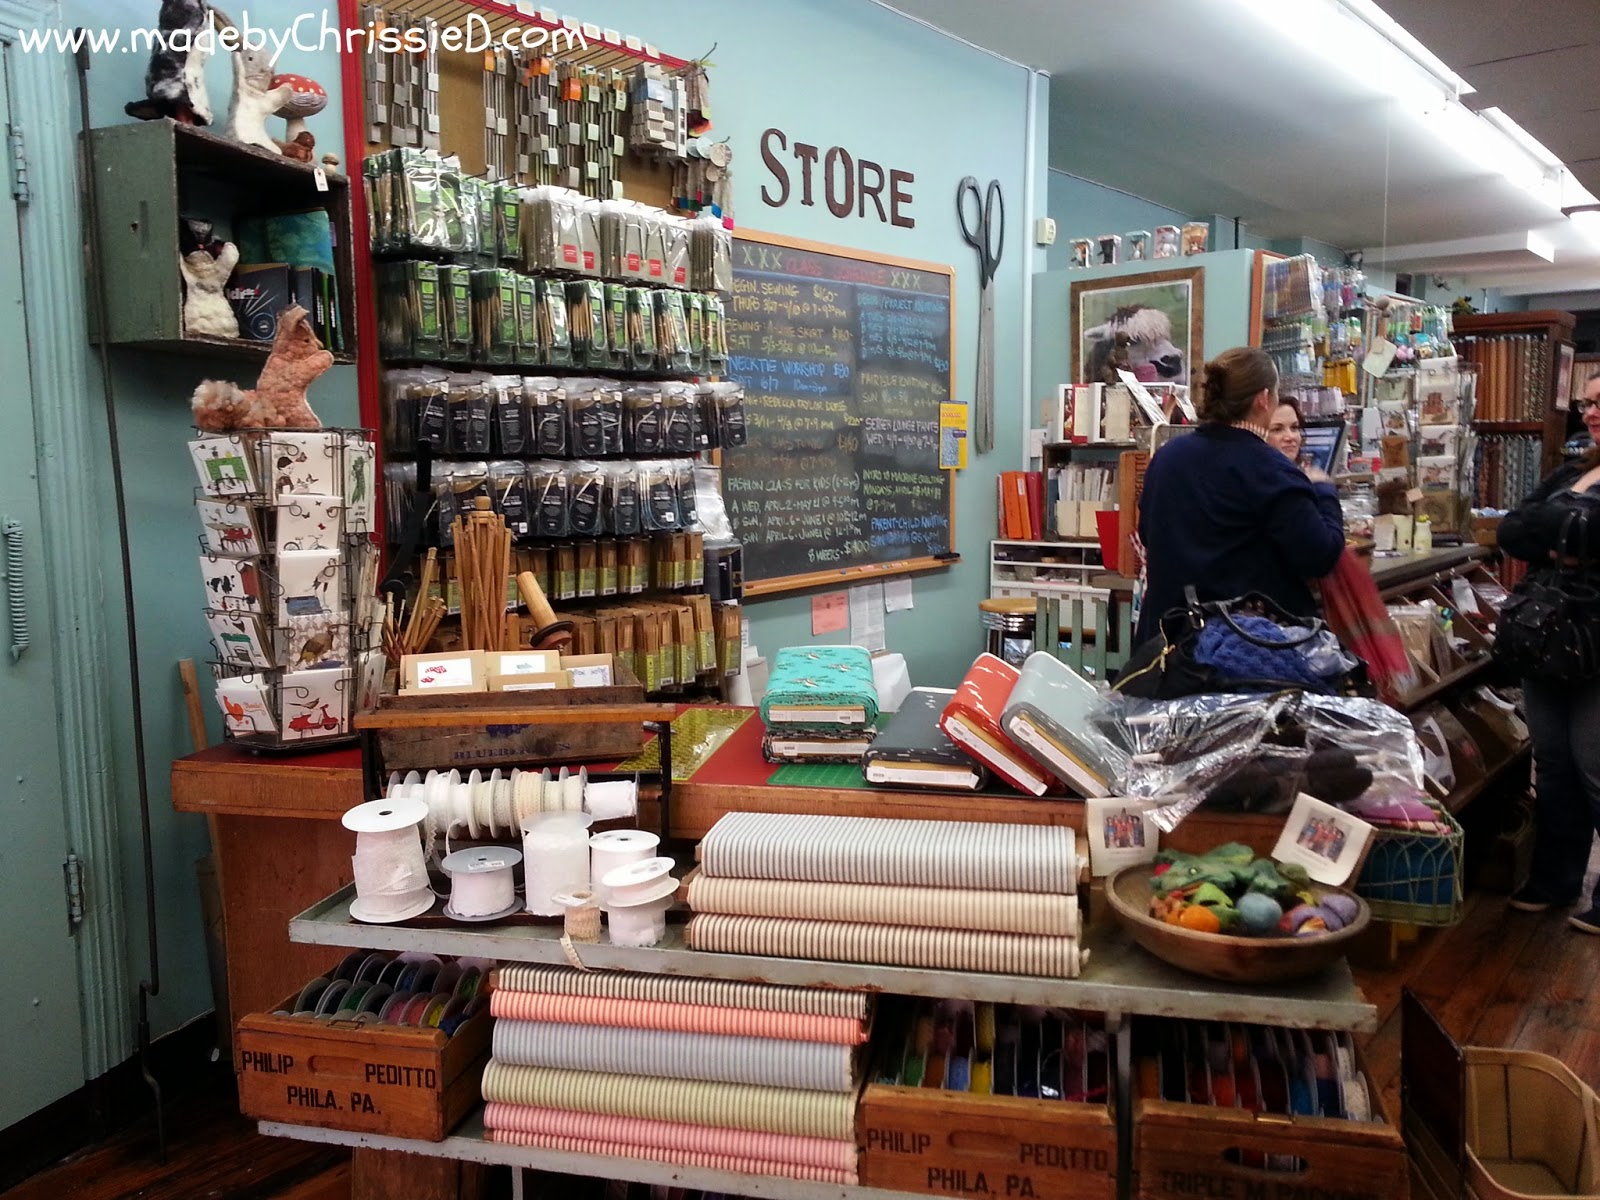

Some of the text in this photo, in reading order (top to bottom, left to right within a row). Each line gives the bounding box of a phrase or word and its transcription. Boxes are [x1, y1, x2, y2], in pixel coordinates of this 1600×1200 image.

[760, 128, 915, 229] STORE
[761, 282, 799, 297] SEWING
[728, 356, 777, 374] NECKTIE
[782, 361, 825, 377] WORKSHOP
[728, 477, 763, 492] FASHION
[765, 477, 793, 492] CLASS
[813, 476, 831, 492] KIDS
[731, 502, 739, 513] A
[807, 547, 815, 563] 8
[242, 1050, 436, 1089] PHILIP PEDITTO
[287, 1085, 382, 1115] PHILA. PA.
[867, 1128, 1108, 1171] PHILIP PEDITTO
[927, 1166, 1041, 1199] PHILA. PA.
